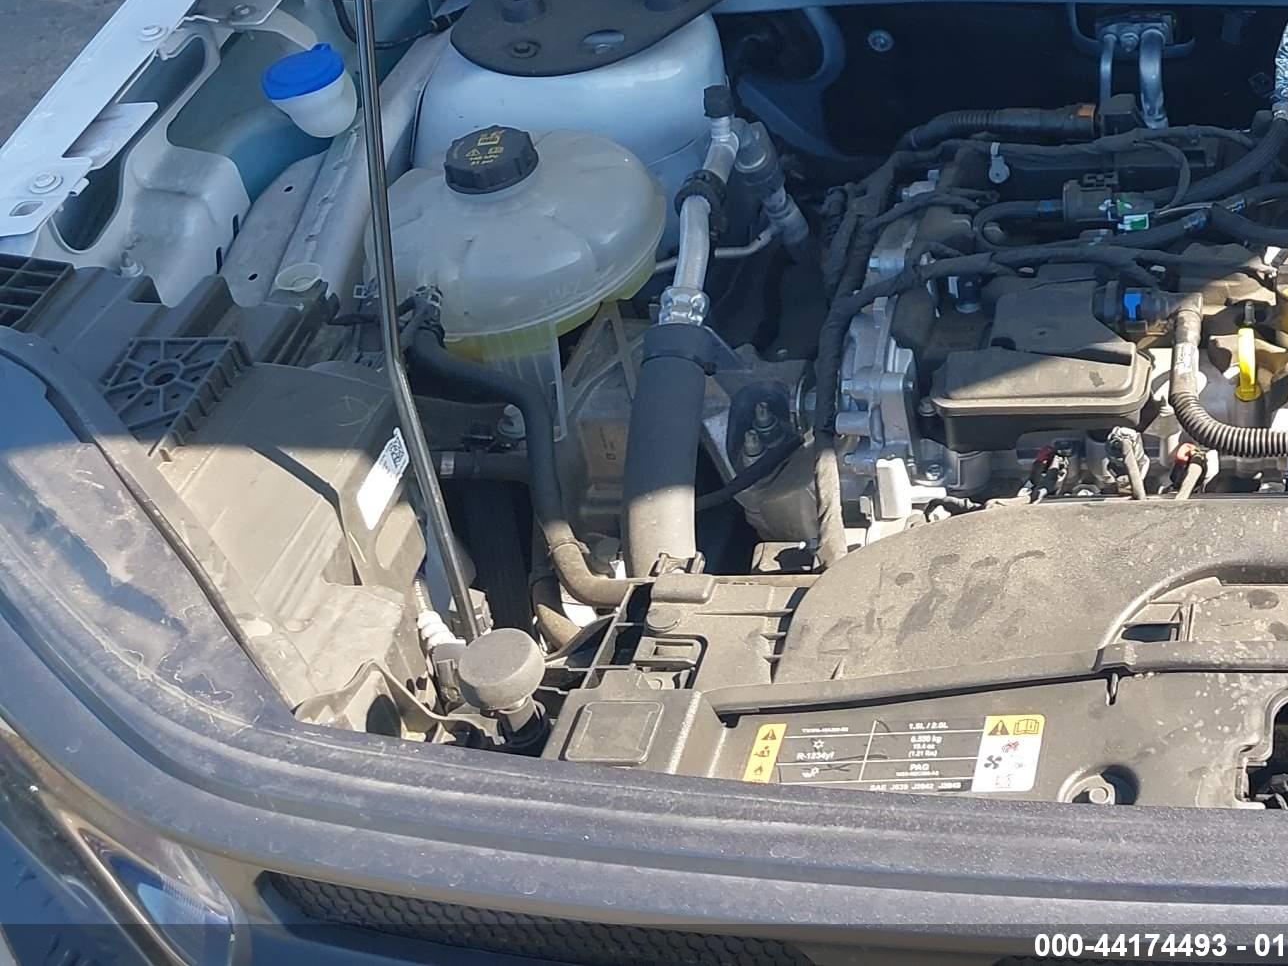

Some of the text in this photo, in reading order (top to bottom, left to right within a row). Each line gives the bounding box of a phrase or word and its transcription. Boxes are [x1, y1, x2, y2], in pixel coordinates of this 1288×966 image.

[931, 721, 949, 729] 2.0L
[931, 735, 942, 744] kg
[909, 763, 930, 771] PAG
